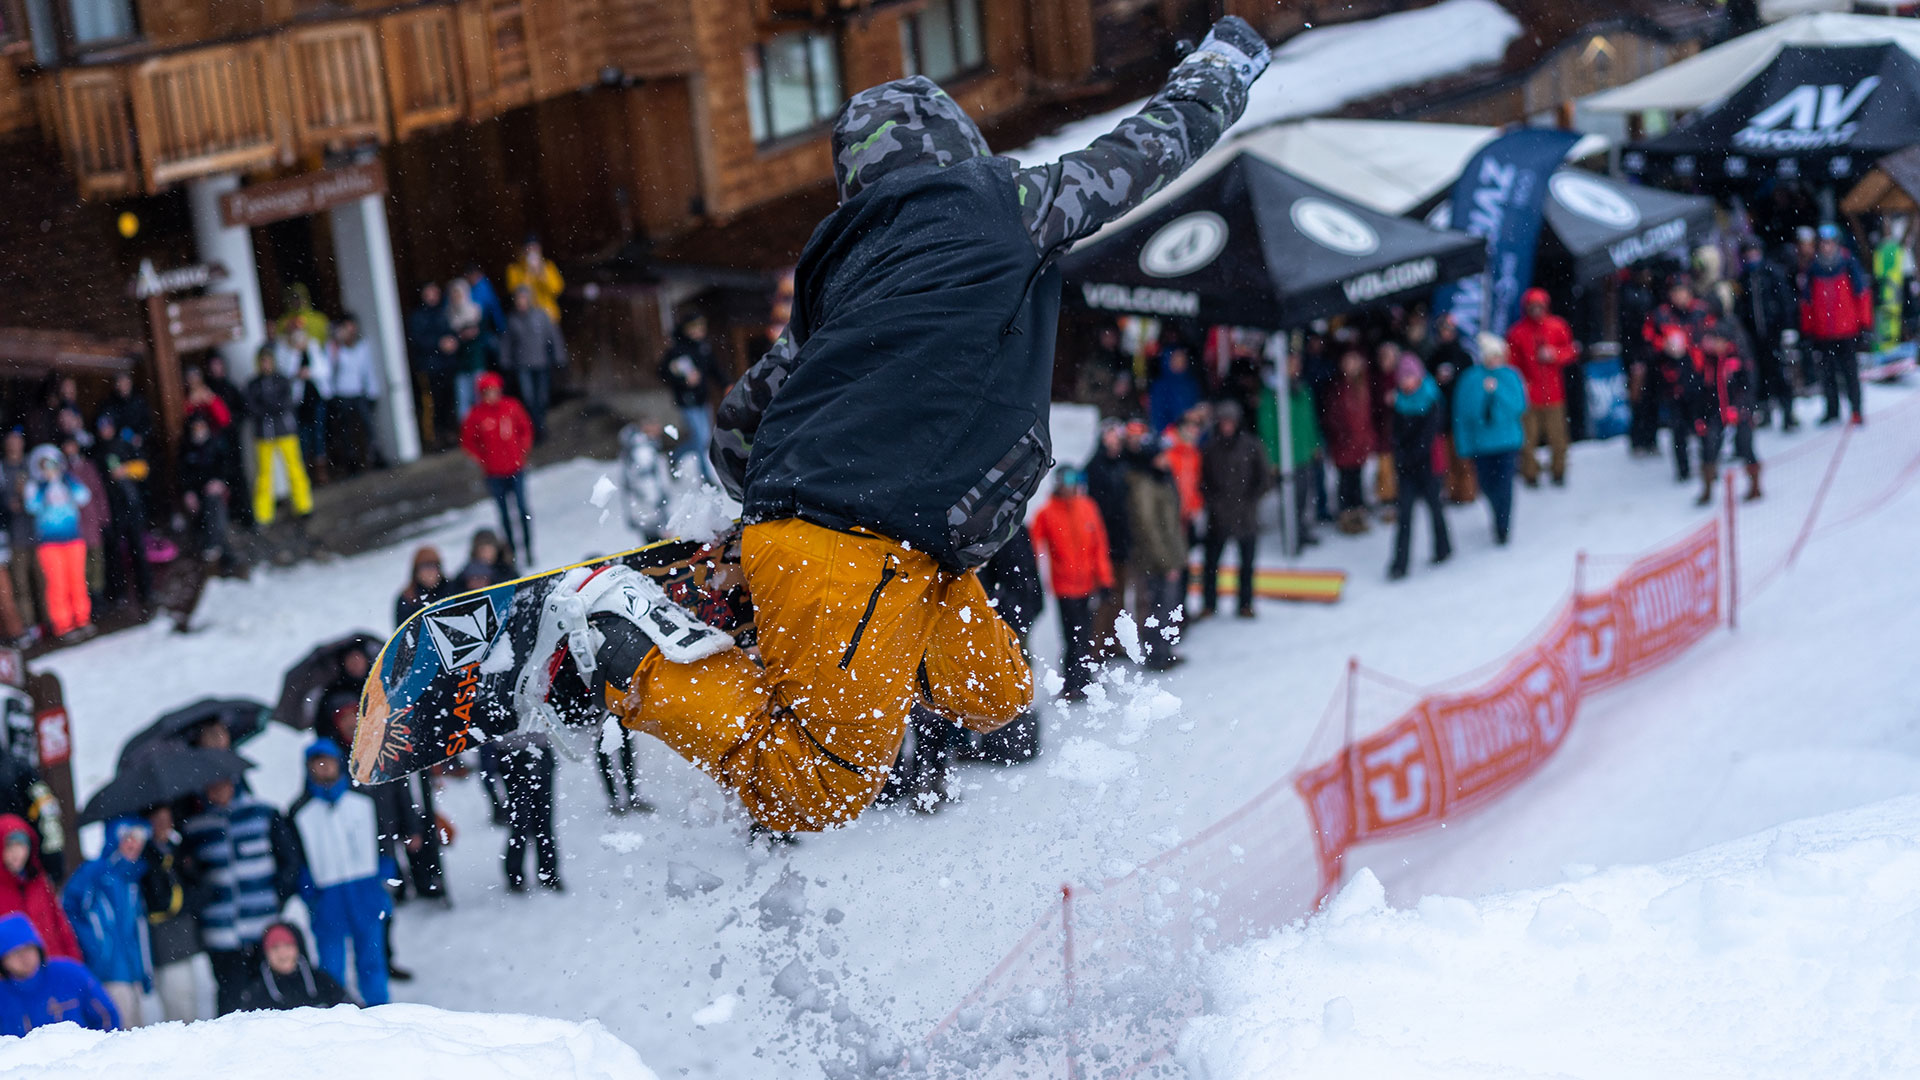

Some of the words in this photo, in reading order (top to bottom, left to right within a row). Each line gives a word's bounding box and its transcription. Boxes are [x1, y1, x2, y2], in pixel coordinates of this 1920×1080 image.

[1607, 219, 1687, 267] VOLCOM
[1082, 282, 1199, 316] VOLCOM
[1342, 257, 1437, 304] VOLCOM
[446, 662, 480, 757] SLASH
